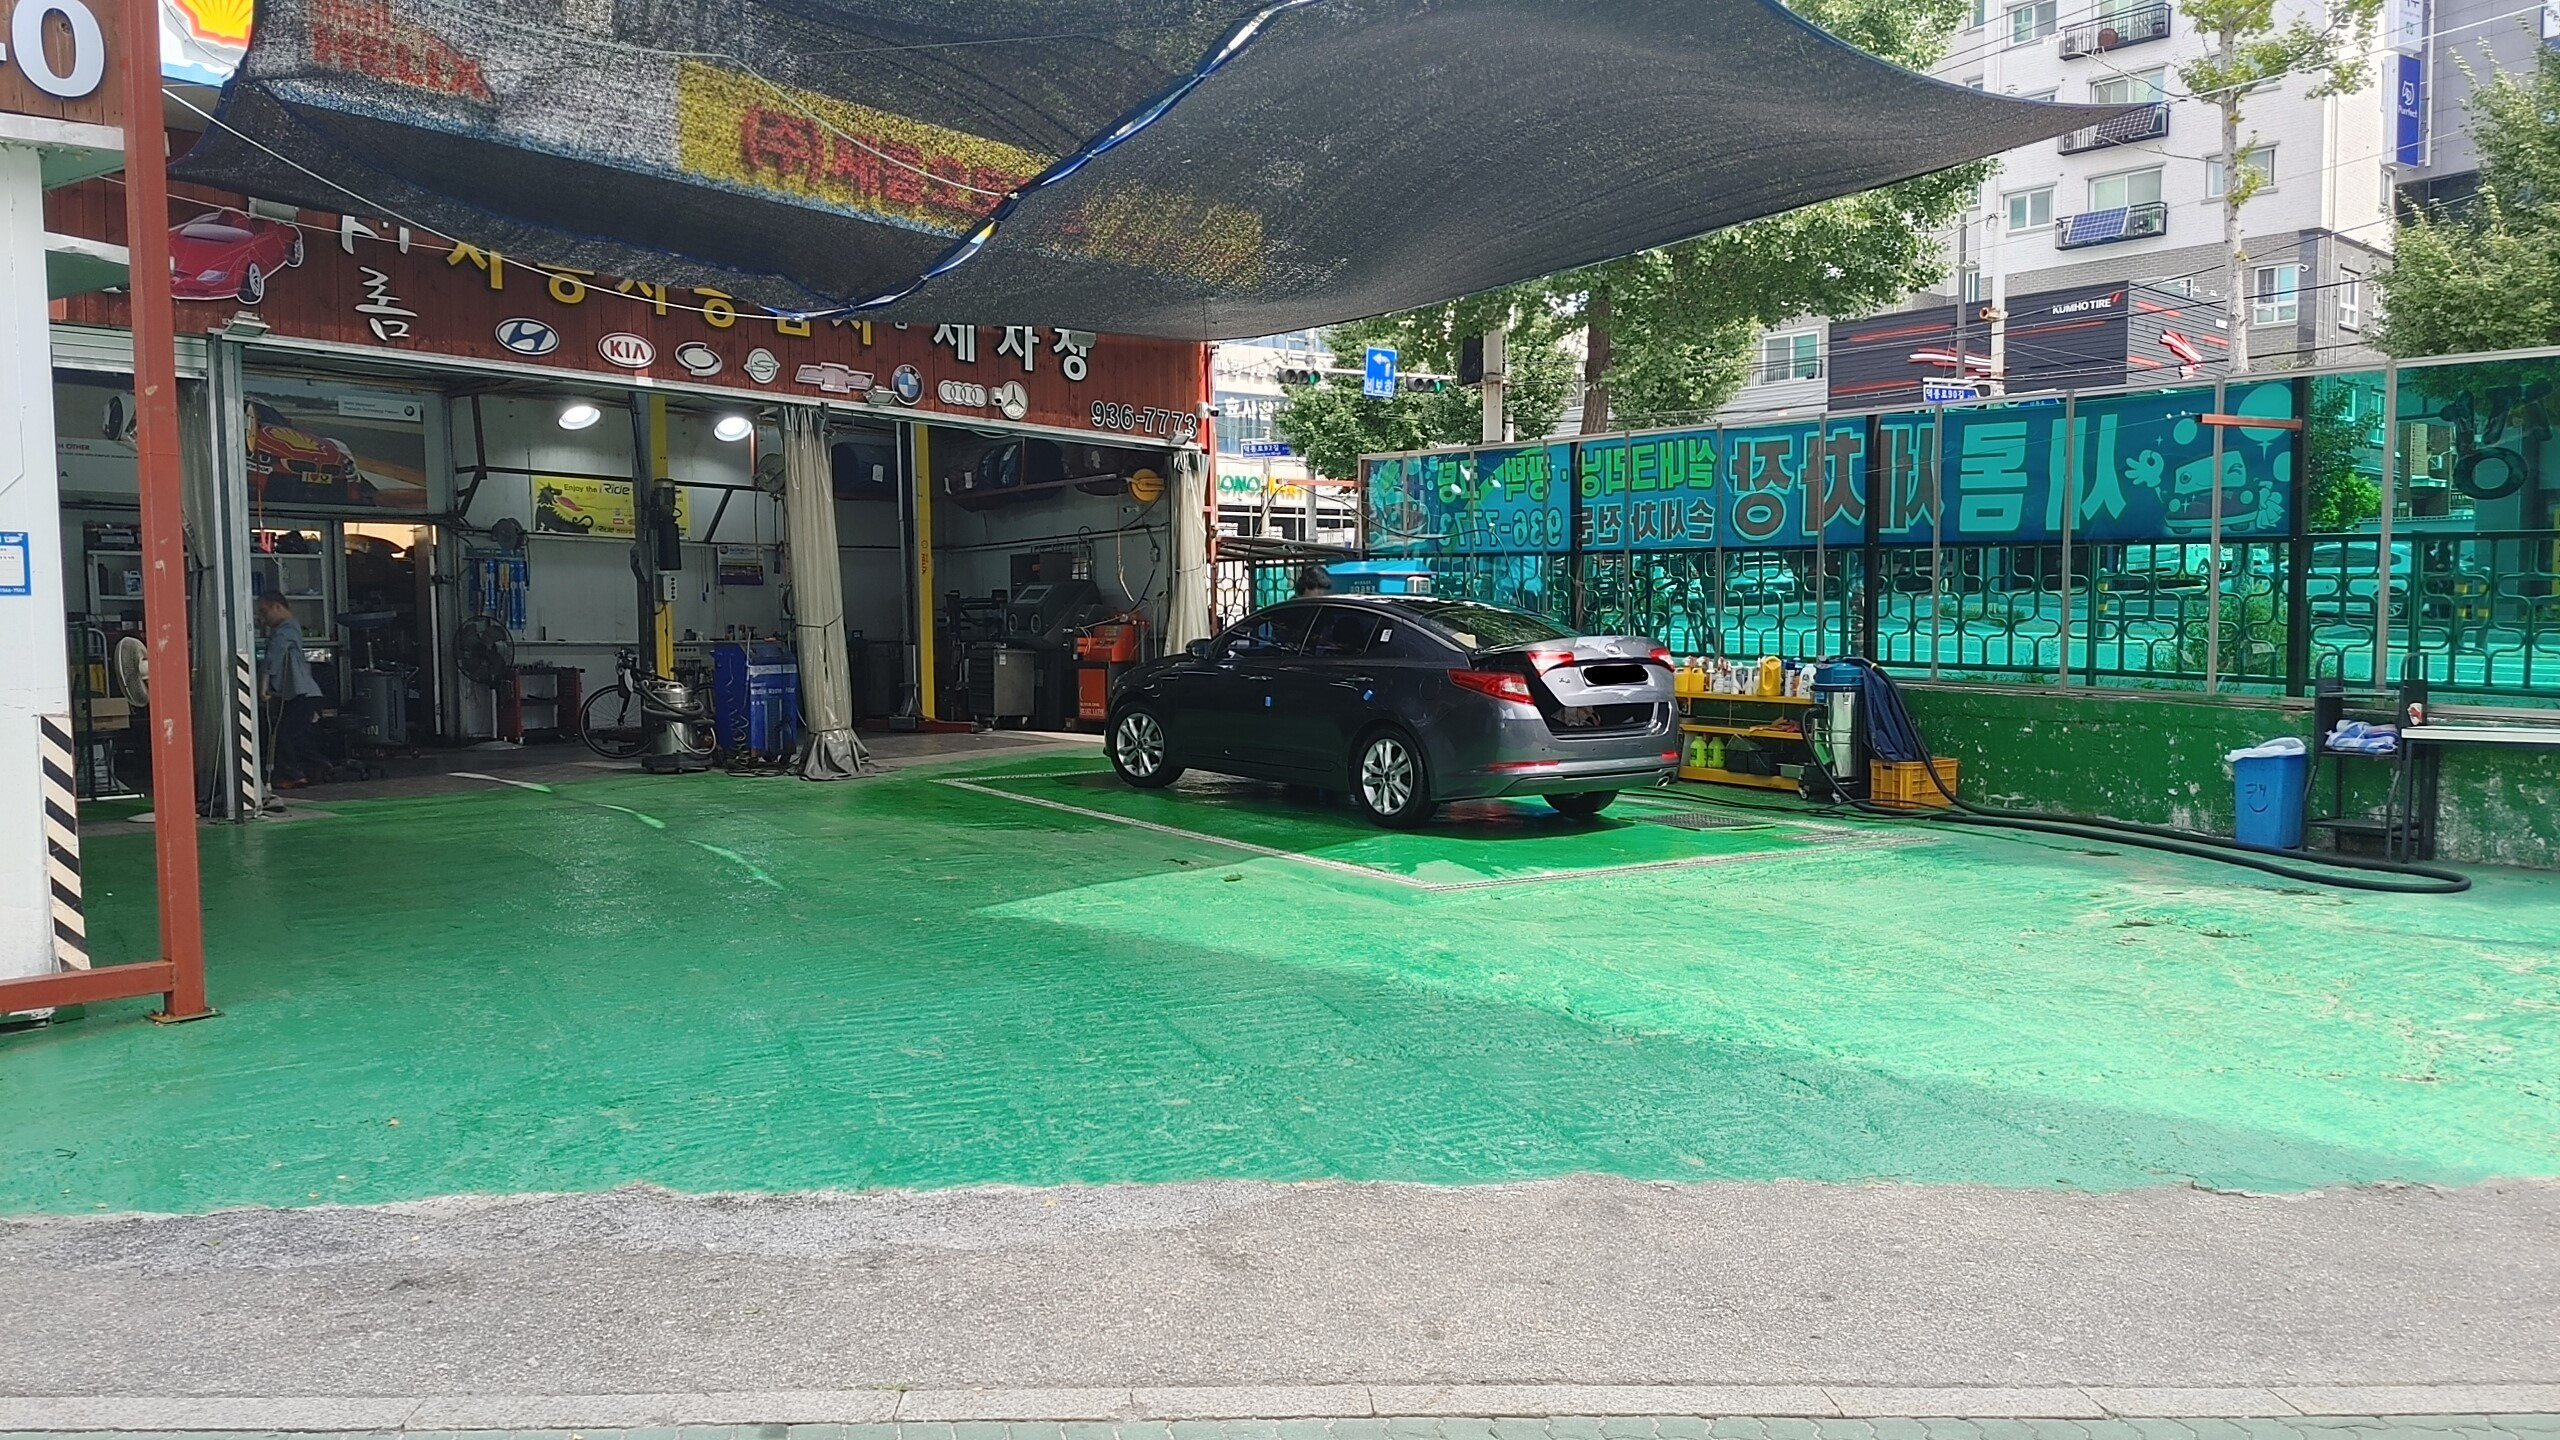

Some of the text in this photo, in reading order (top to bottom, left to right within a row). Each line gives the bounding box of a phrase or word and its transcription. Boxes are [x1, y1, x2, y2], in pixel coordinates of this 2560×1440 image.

[0, 0, 105, 97] 0
[2052, 298, 2112, 315] KUMHO TIRE
[609, 338, 647, 362] KIA
[1365, 377, 1393, 394] 비보호
[1090, 400, 1198, 437] 936-7773
[563, 483, 584, 494] Enjoy
